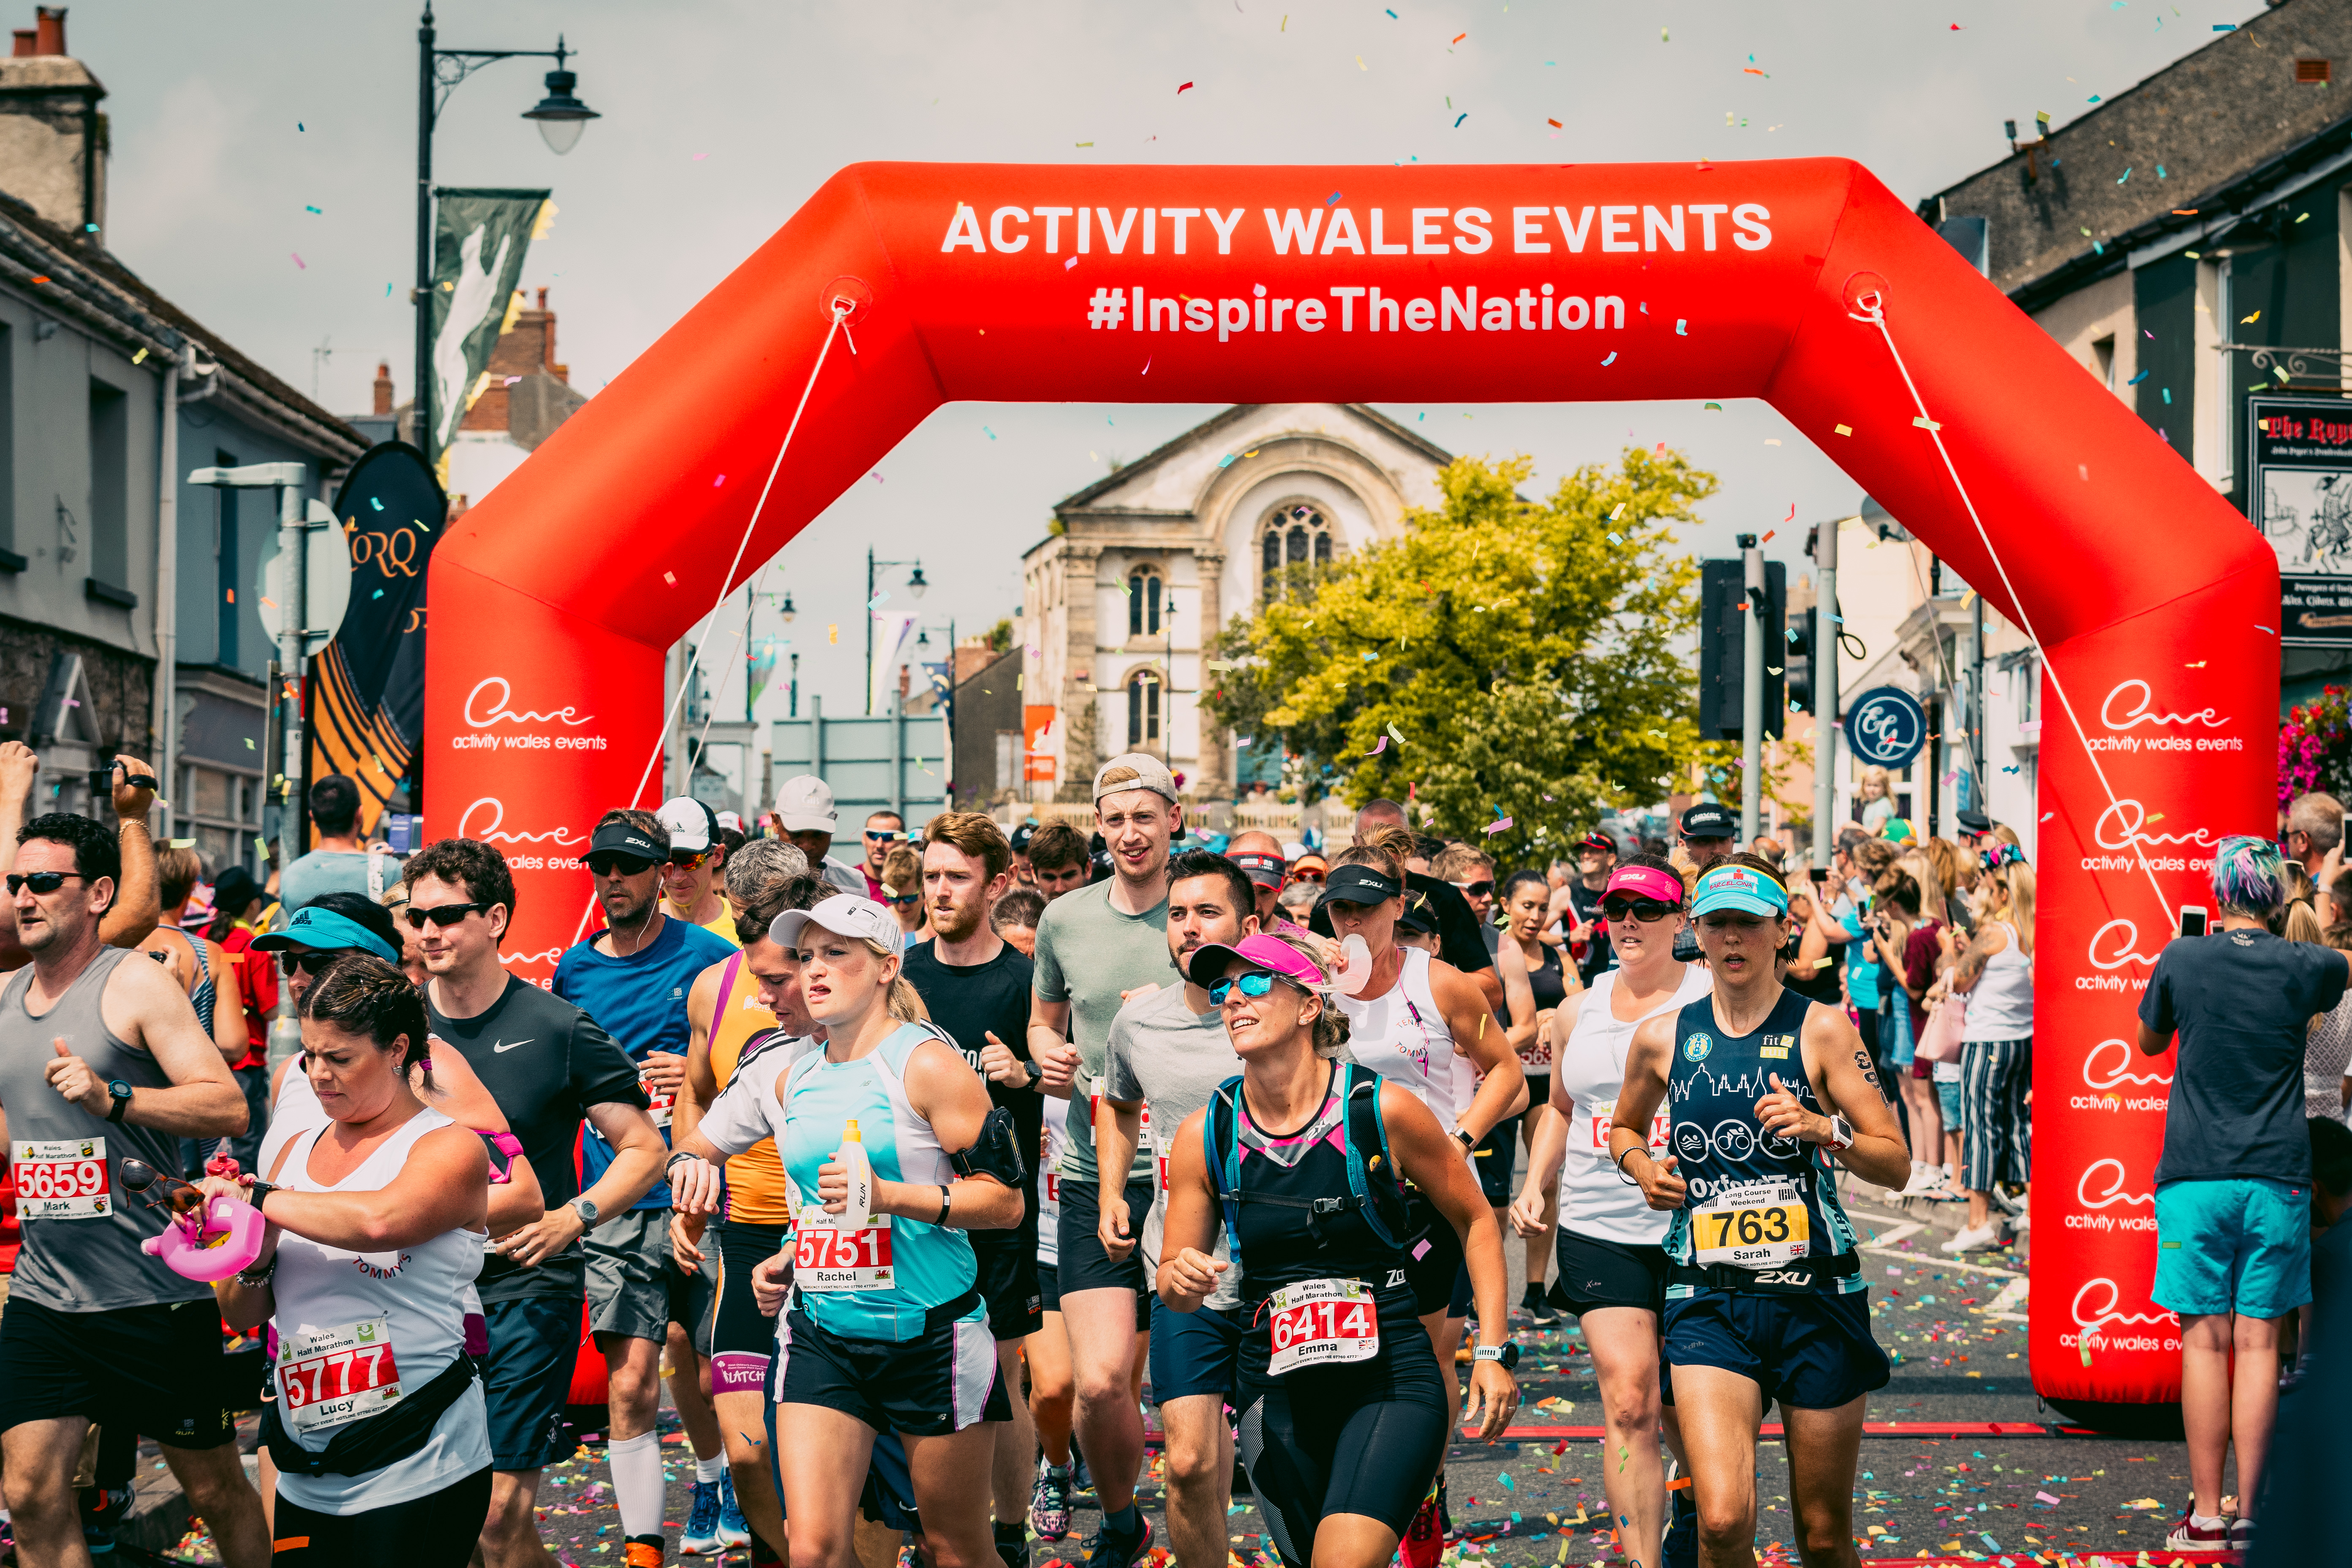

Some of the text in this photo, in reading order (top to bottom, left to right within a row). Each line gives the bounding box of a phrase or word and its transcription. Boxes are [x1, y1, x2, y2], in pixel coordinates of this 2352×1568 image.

[941, 204, 1773, 255] ACTIVITY WALES EVENTS
[1087, 283, 1625, 342] #InspireTheNation
[2264, 415, 2304, 441] The
[452, 734, 607, 751] activity wales events
[2088, 736, 2243, 753] activity wales events
[625, 837, 651, 848] 2XU
[2081, 855, 2134, 874] activity
[2138, 856, 2185, 871] wales
[1359, 879, 1383, 888] 2XU
[1619, 873, 1646, 882] 2XU
[1709, 868, 1759, 885] IRONMAN
[1709, 880, 1753, 890] BARCELONA
[2075, 975, 2128, 993] activity
[1763, 1034, 1779, 1045] fit
[1761, 1048, 1787, 1057] run
[2070, 1094, 2121, 1113] activity
[17, 1161, 103, 1197] 5659
[1725, 1188, 1772, 1199] Long Course
[1730, 1197, 1766, 1206] Weekend
[44, 1201, 71, 1210] Mark
[1712, 1206, 1790, 1248] 763
[2065, 1214, 2158, 1232] activity wale
[798, 1229, 880, 1268] 5751
[1733, 1248, 1771, 1260] Sarah
[353, 1253, 411, 1279] TOMMY'S
[817, 1271, 857, 1282] Rachel
[1754, 1271, 1812, 1285] 2XU
[1302, 1283, 1326, 1292] Wales
[1291, 1290, 1343, 1304] Half Marathon
[1029, 1305, 1041, 1315] RUN
[1274, 1302, 1370, 1349] 6414
[310, 1333, 335, 1344] Wales
[2113, 1335, 2160, 1353] wales
[297, 1339, 354, 1357] Half Marathon
[1298, 1342, 1338, 1356] Emma
[283, 1345, 384, 1407] 5777
[319, 1400, 354, 1416] Lucy
[336, 1413, 357, 1421] HOTLINE
